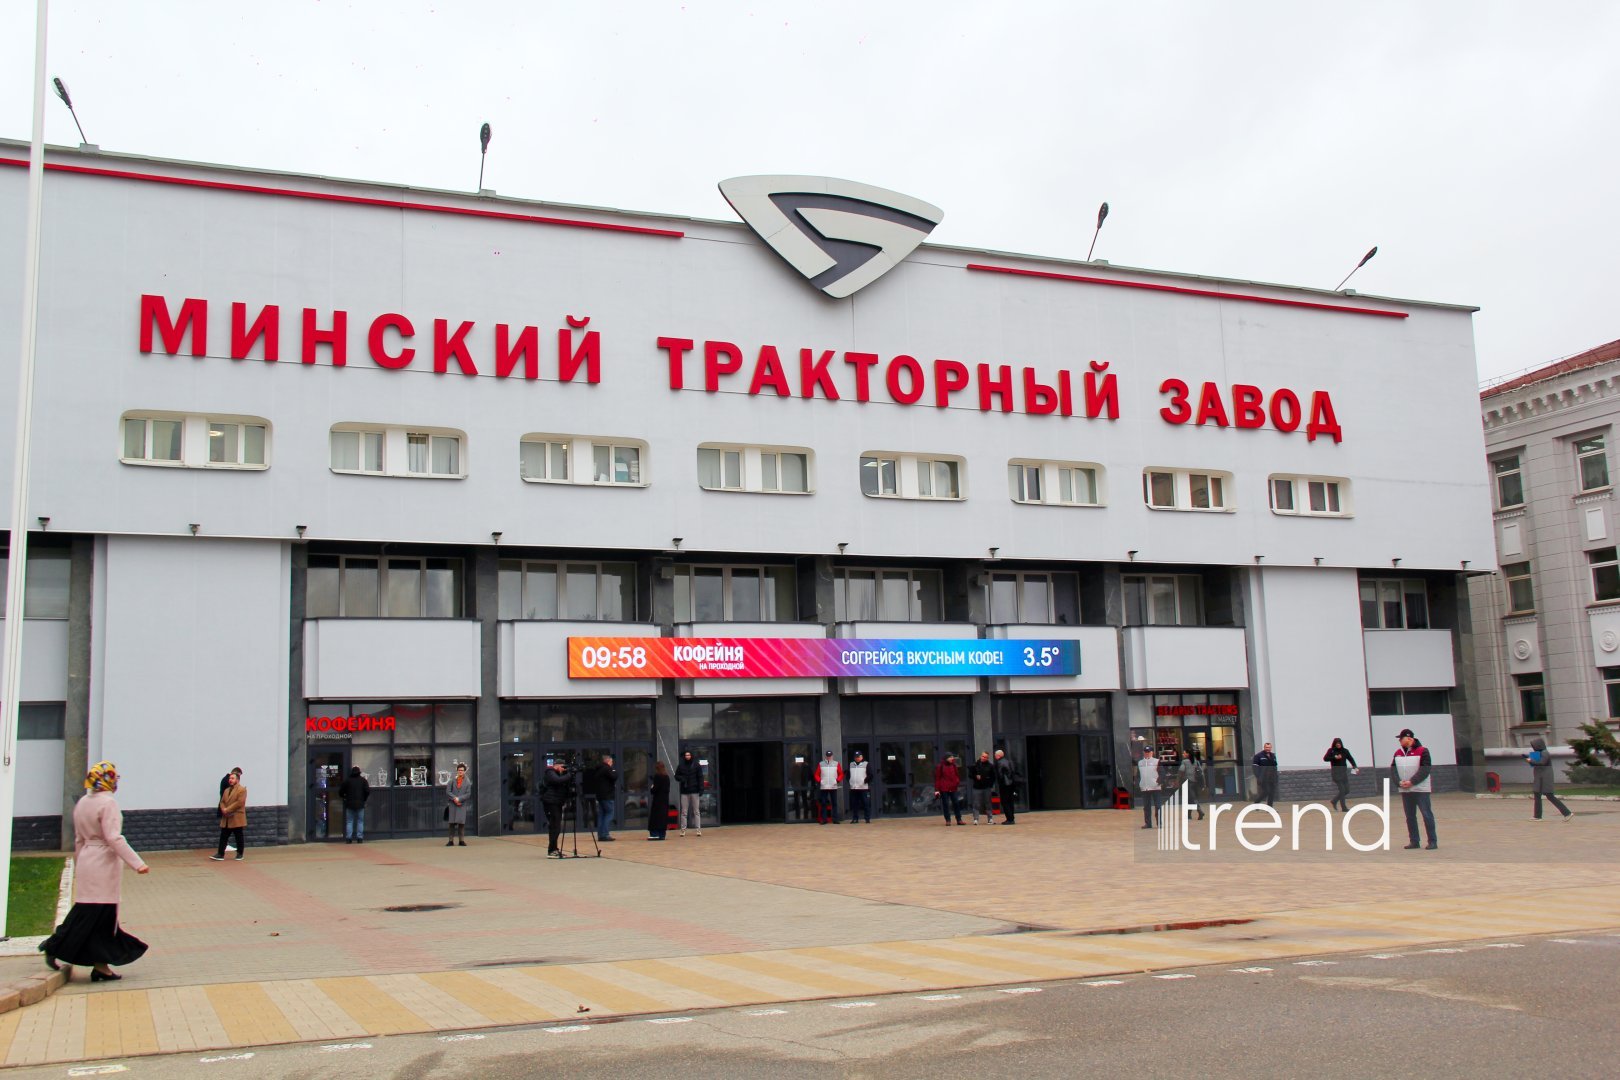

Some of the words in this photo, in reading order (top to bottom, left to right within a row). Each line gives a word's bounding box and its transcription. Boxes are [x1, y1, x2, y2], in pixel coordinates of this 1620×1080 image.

[138, 293, 602, 385] МИНСКИЙ
[656, 335, 1121, 421] ТРАКТОРНЫЙ
[1159, 378, 1343, 443] ЗАВОД
[581, 646, 648, 668] 09:58
[673, 643, 744, 662] КОФЕЙНЯ
[841, 647, 904, 666] СОГРЕЙСЯ
[907, 651, 965, 665] ВКУСНЫМ
[968, 651, 1003, 665] КОФЕ!
[1023, 647, 1060, 667] 3.5°
[699, 662, 708, 670] НА
[709, 661, 745, 671] ПРОХОДНОЙ
[1156, 705, 1195, 716] BELARUS
[305, 713, 396, 732] КОФЕЙНЯ
